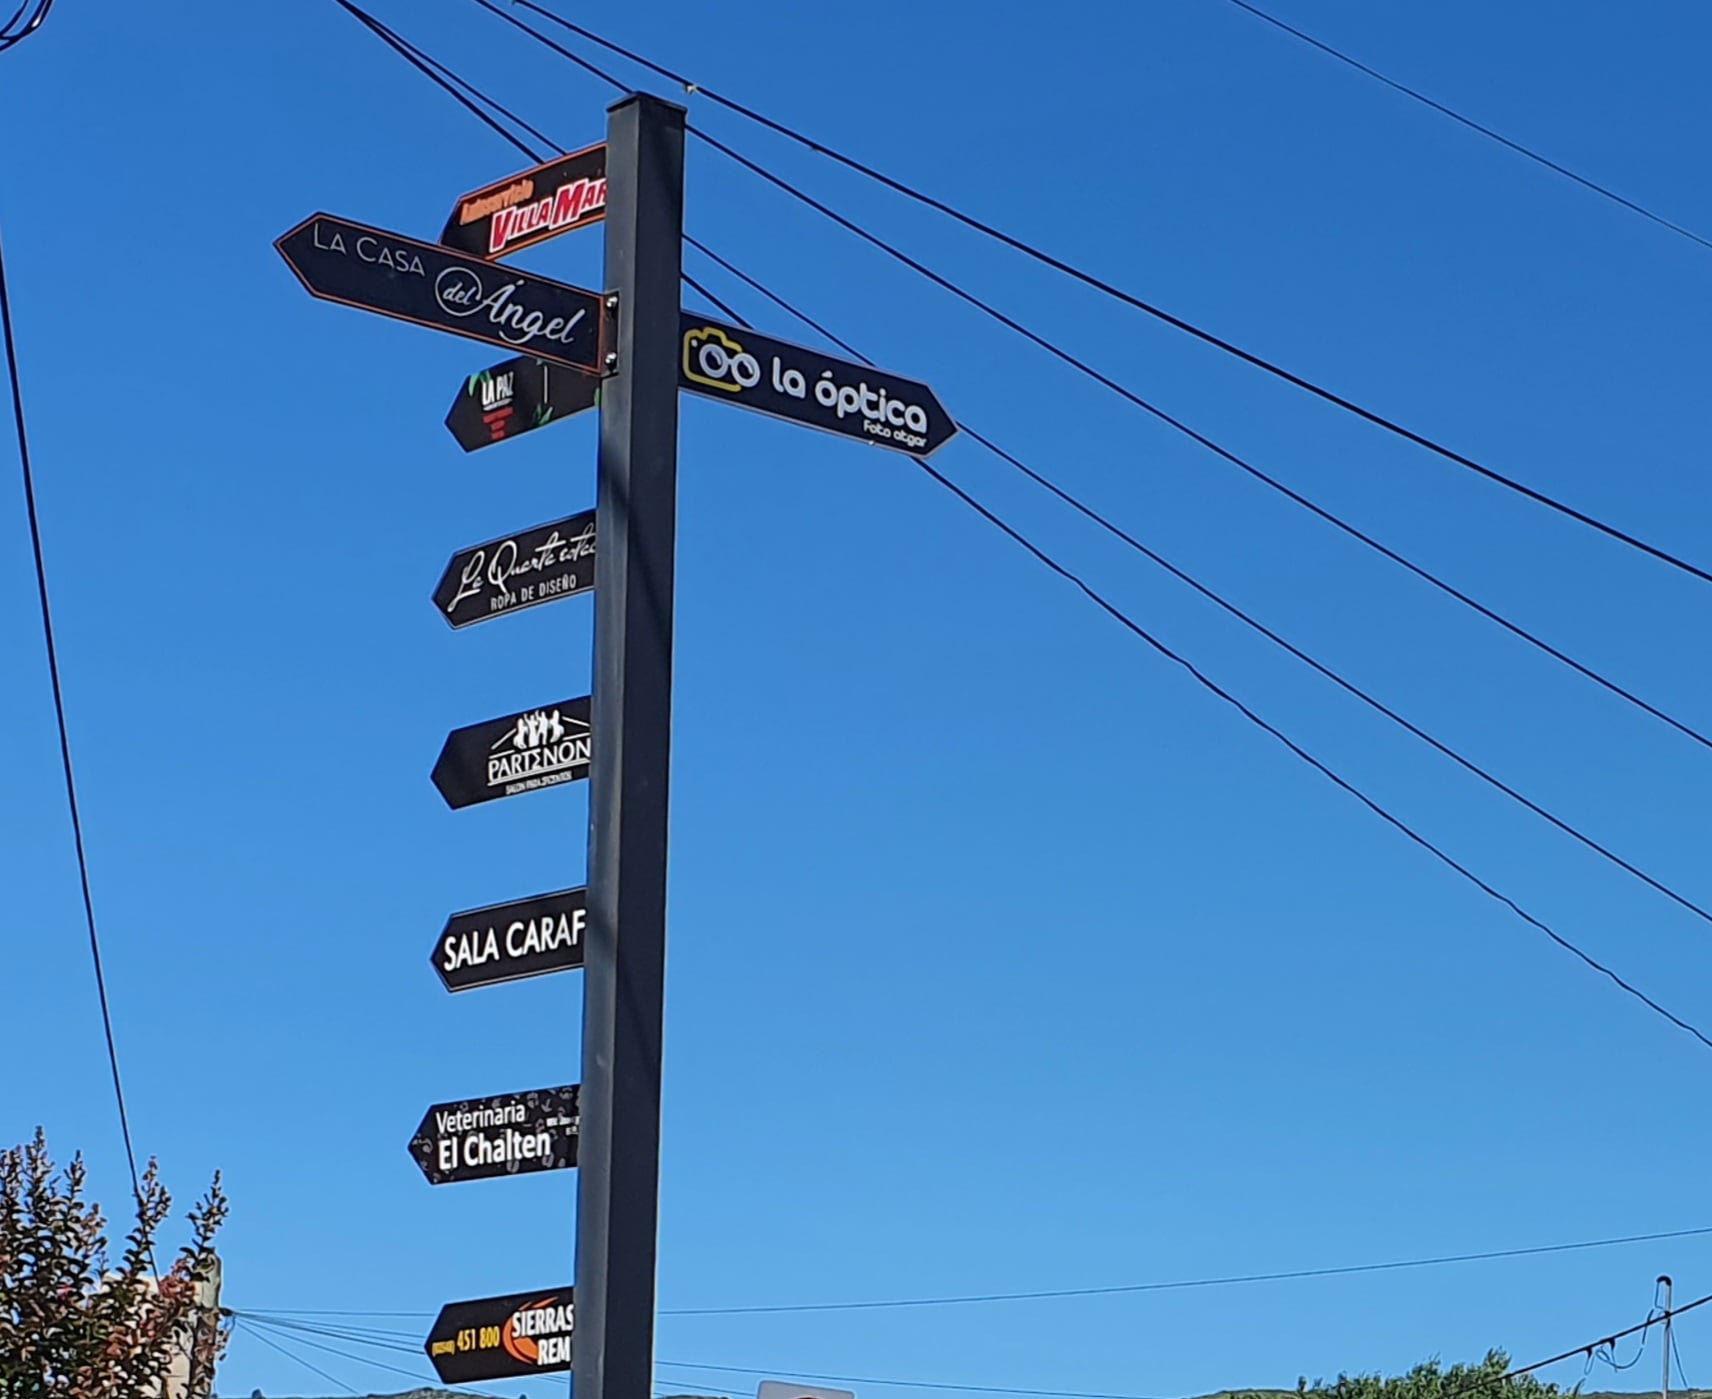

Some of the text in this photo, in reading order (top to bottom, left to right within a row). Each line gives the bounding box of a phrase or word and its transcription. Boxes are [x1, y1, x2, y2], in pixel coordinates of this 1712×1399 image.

[489, 197, 553, 254] VILLA
[313, 223, 426, 277] LA CASA
[441, 280, 586, 344] del Ángel
[481, 379, 495, 407] LA
[496, 371, 514, 400] PAZ
[772, 356, 928, 433] la óptica
[863, 419, 891, 438] Foto
[490, 573, 577, 611] ROPA DE DISEÑO
[443, 908, 587, 972] SALA CARAF
[436, 1099, 526, 1134] Veterinaria
[438, 1128, 551, 1171] El Chalten
[456, 1327, 476, 1352] 451
[479, 1325, 500, 1349] 800
[511, 1303, 575, 1338] SIERRAS
[537, 1336, 572, 1366] REM
